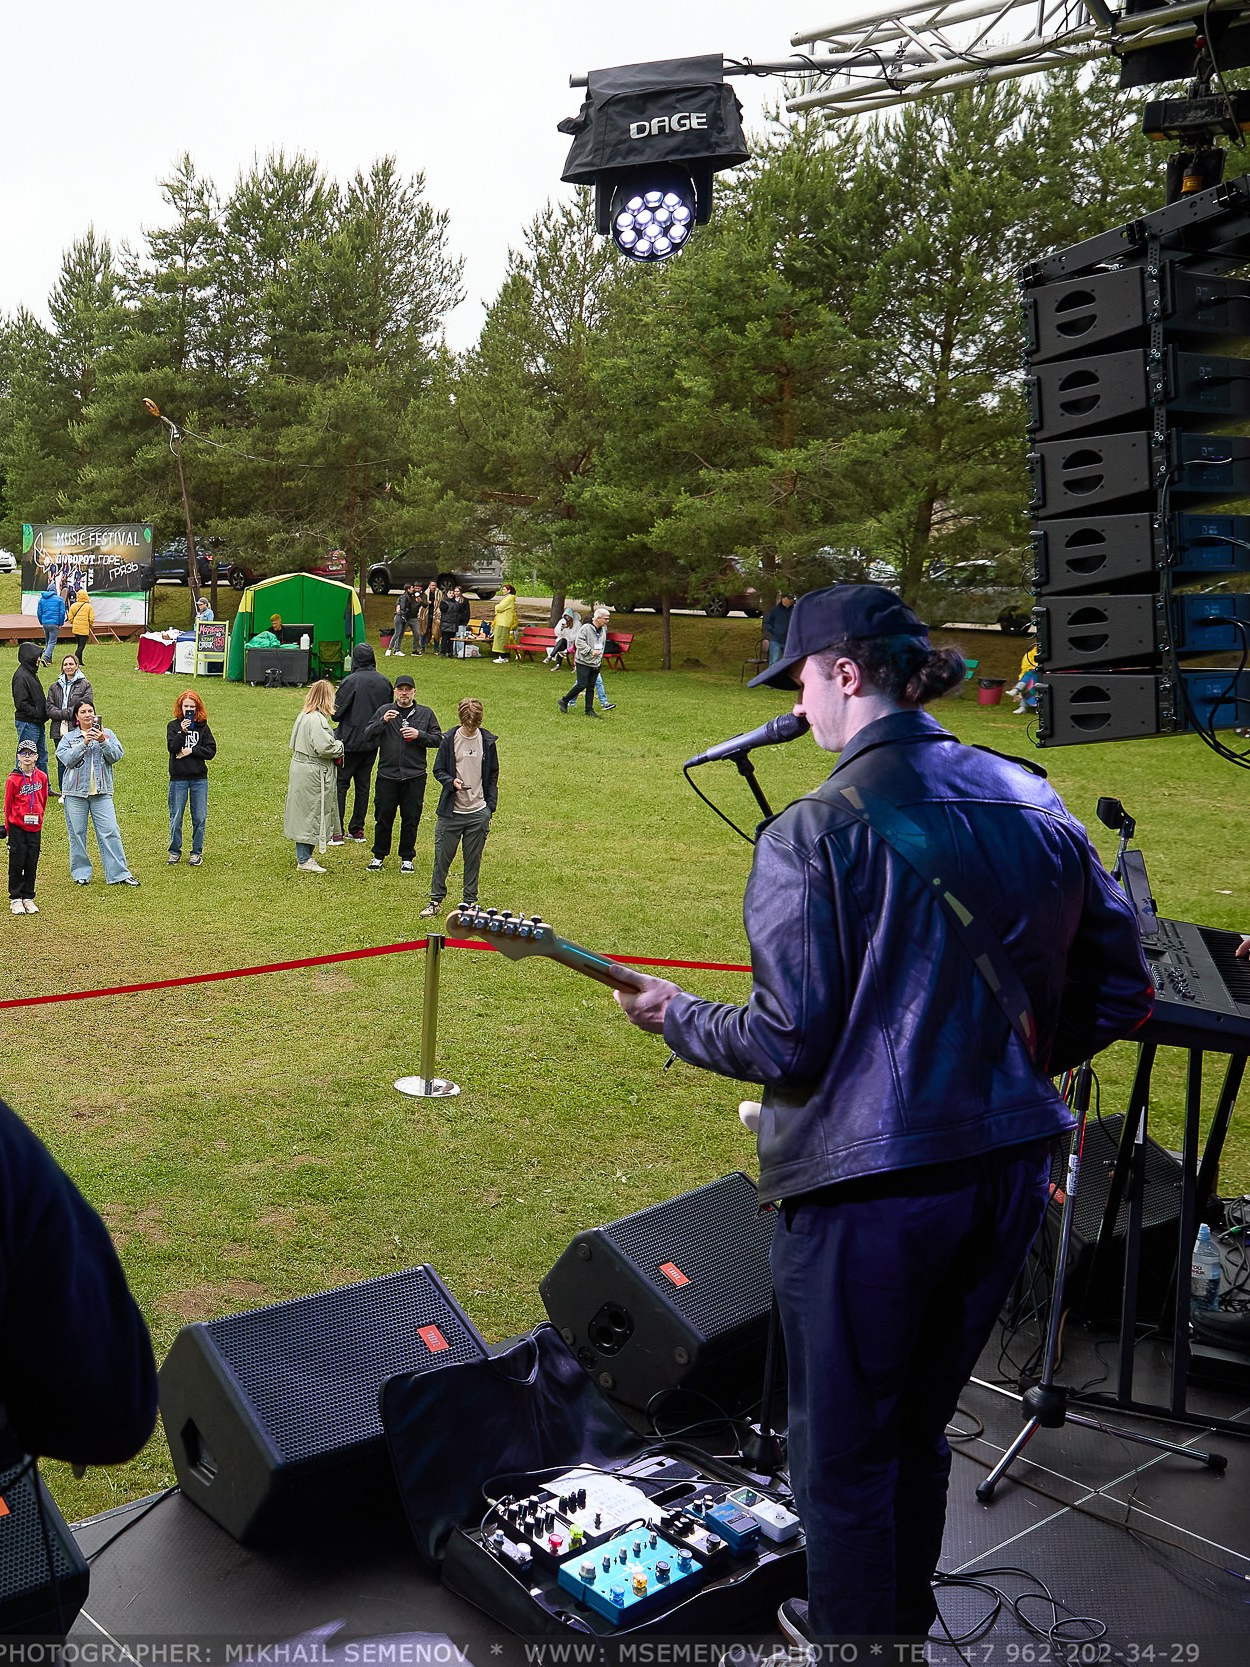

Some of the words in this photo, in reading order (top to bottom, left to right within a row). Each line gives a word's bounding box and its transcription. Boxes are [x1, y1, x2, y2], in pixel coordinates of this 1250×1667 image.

[629, 112, 708, 139] DAGE
[55, 532, 86, 546] MUSIC
[89, 531, 140, 546] FESTIVAL
